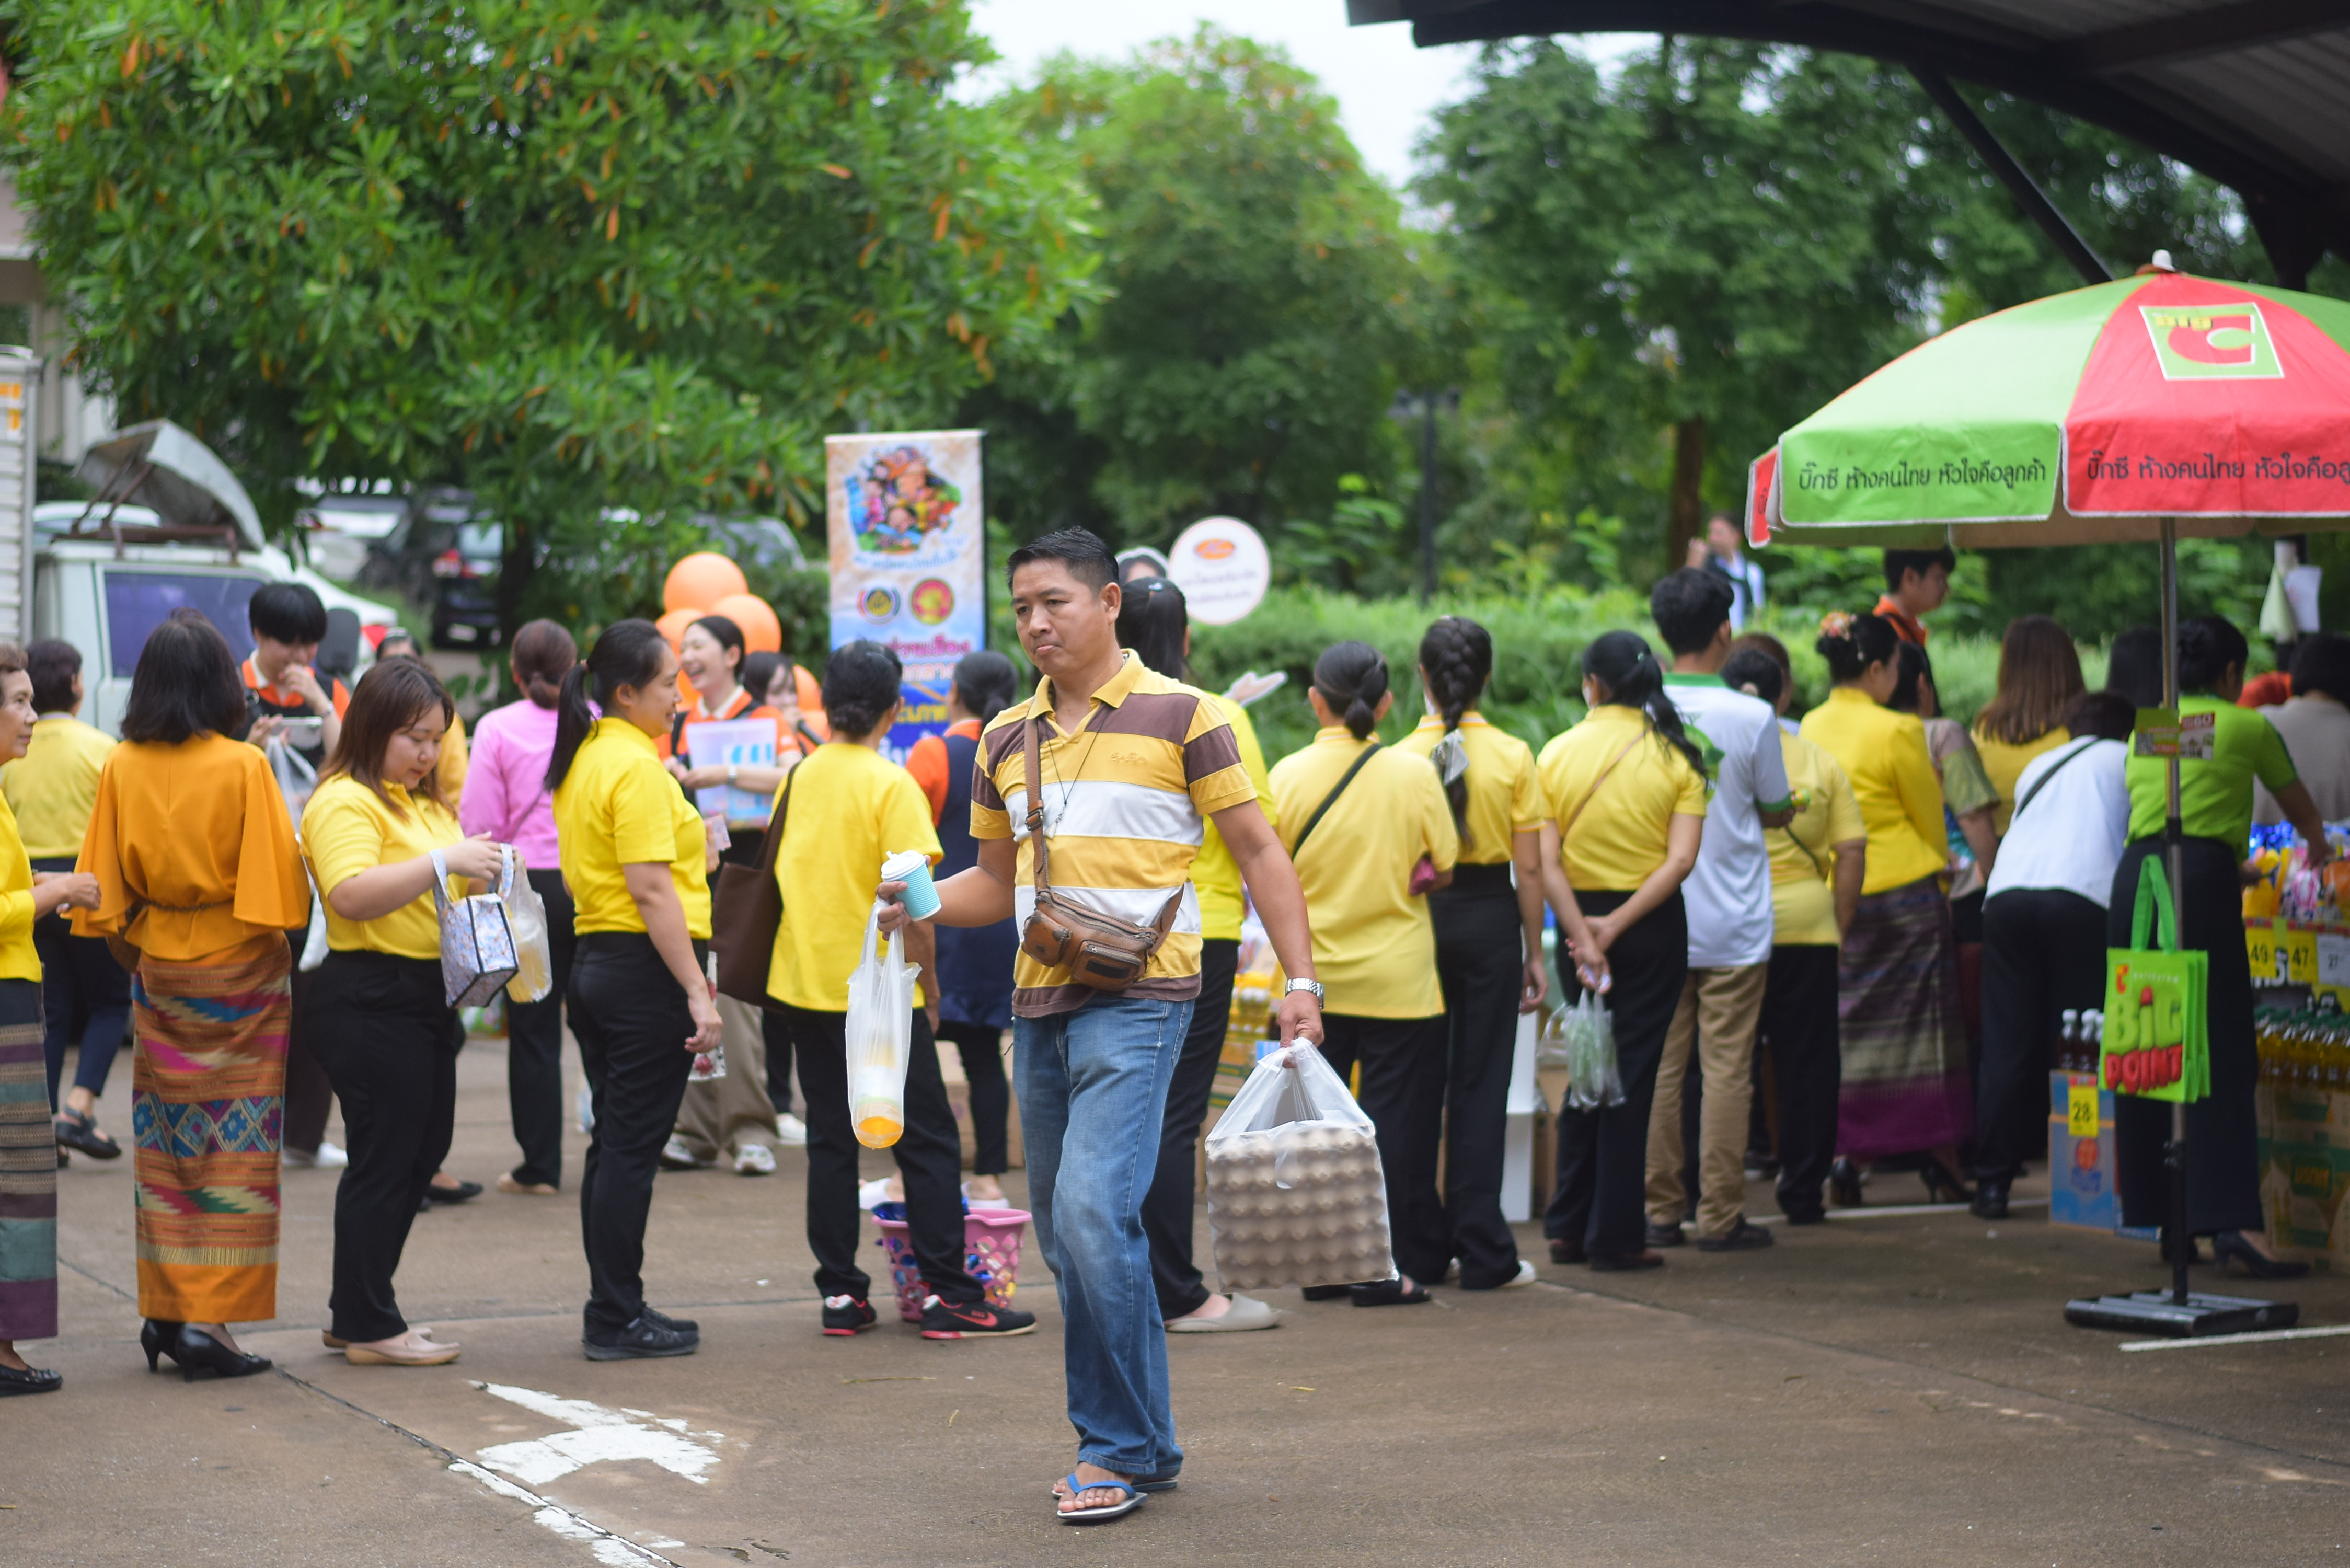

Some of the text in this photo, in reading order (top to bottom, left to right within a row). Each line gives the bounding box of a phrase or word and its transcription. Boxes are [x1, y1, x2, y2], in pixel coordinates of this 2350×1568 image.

[2156, 315, 2212, 331] Big
[1798, 457, 2046, 490] บิ๊กซี ห้างคนไทย หัวใจคือลูกค้า
[2087, 449, 2350, 485] บิ๊กซี ห้างคนไทย หัวใจคือลู
[2105, 1044, 2184, 1094] POINT
[2073, 1100, 2090, 1123] 28
[971, 1310, 986, 1318] NIKE
